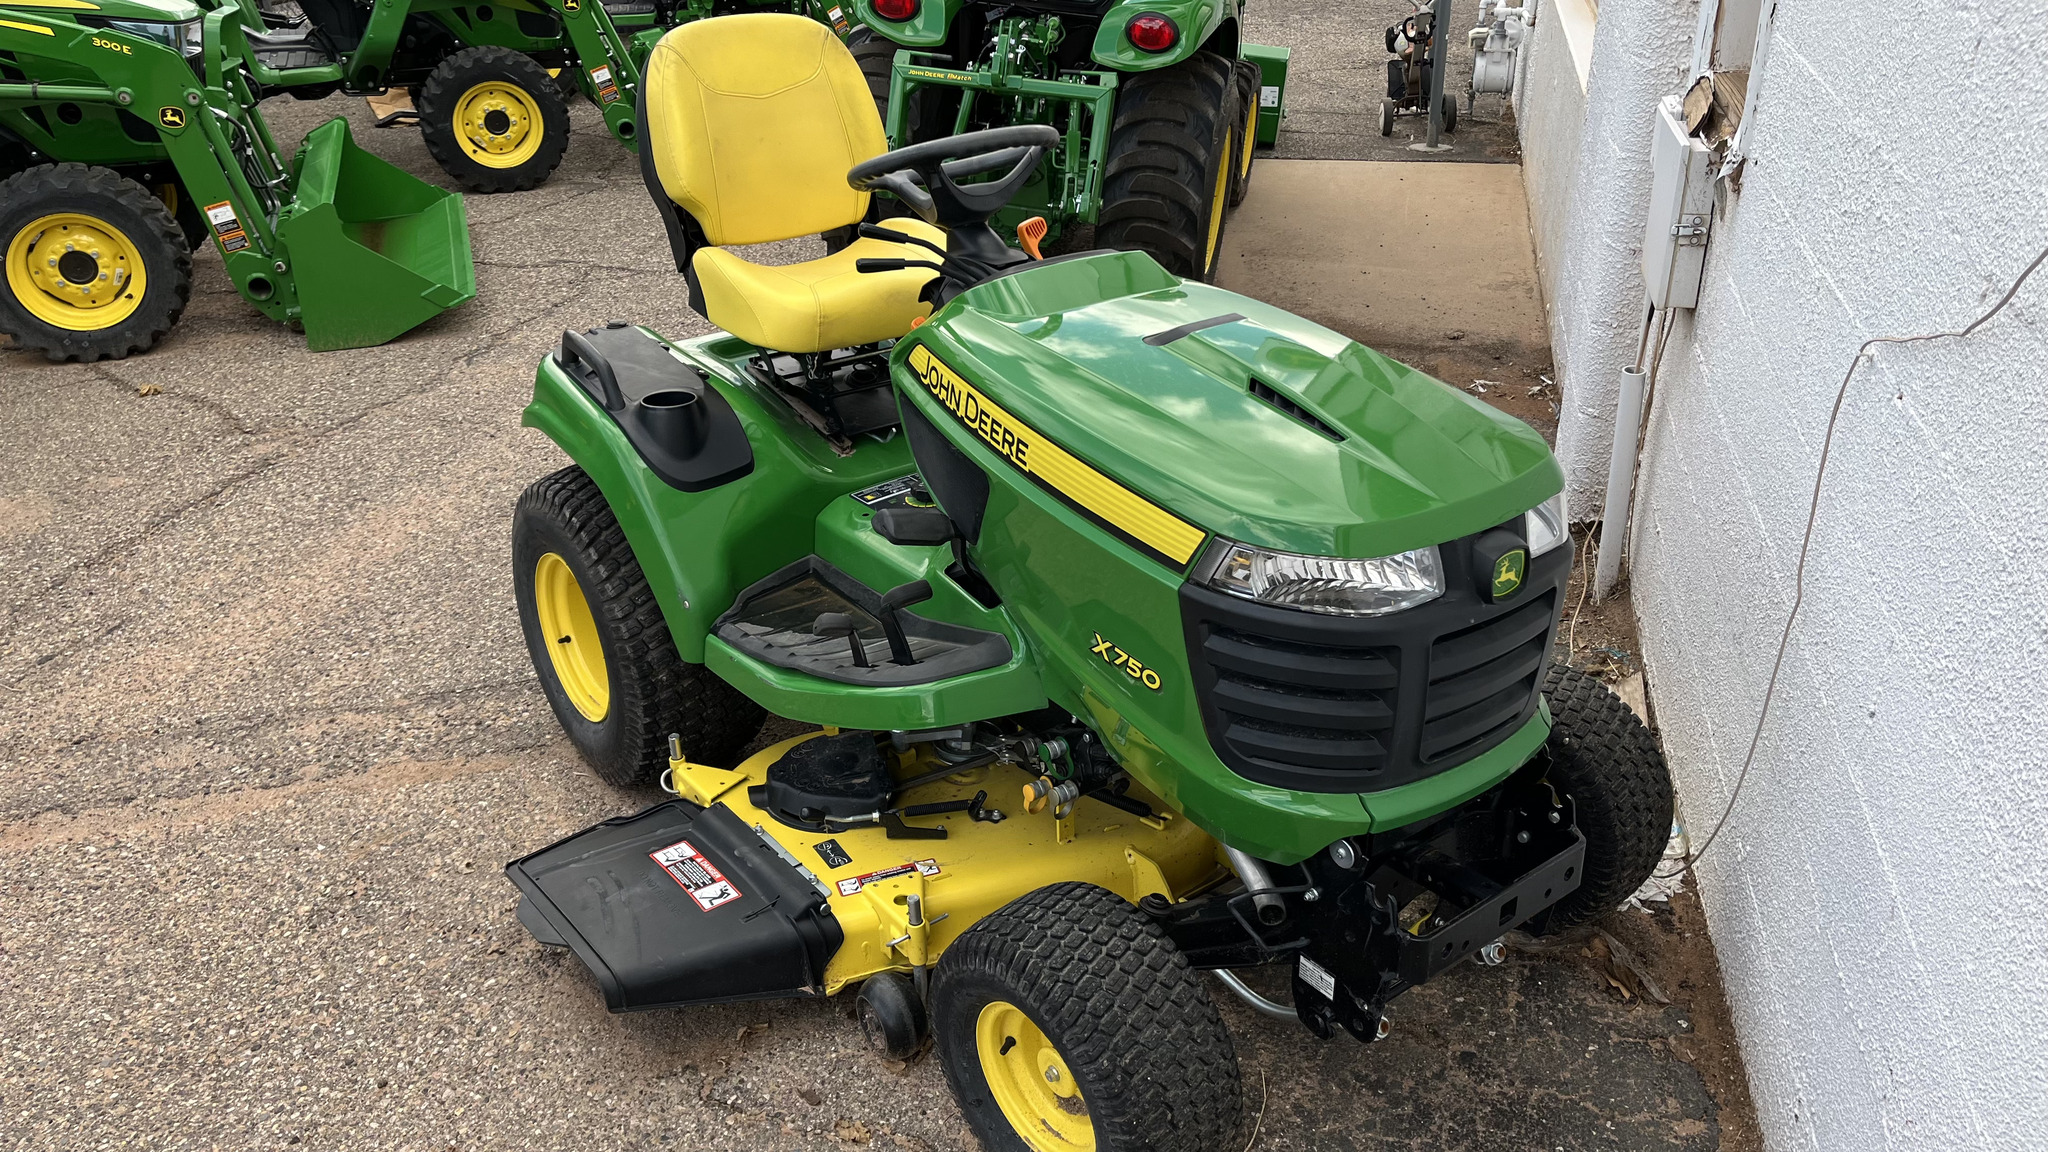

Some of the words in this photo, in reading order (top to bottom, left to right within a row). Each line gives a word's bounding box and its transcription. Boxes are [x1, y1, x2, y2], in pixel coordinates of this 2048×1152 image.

[908, 69, 924, 77] JOHN
[924, 71, 945, 79] DEERE
[920, 355, 962, 415] JOHN
[964, 391, 1029, 468] DEERE
[1089, 631, 1162, 691] X750
[700, 861, 722, 879] DANGER
[877, 866, 902, 875] DANGER
